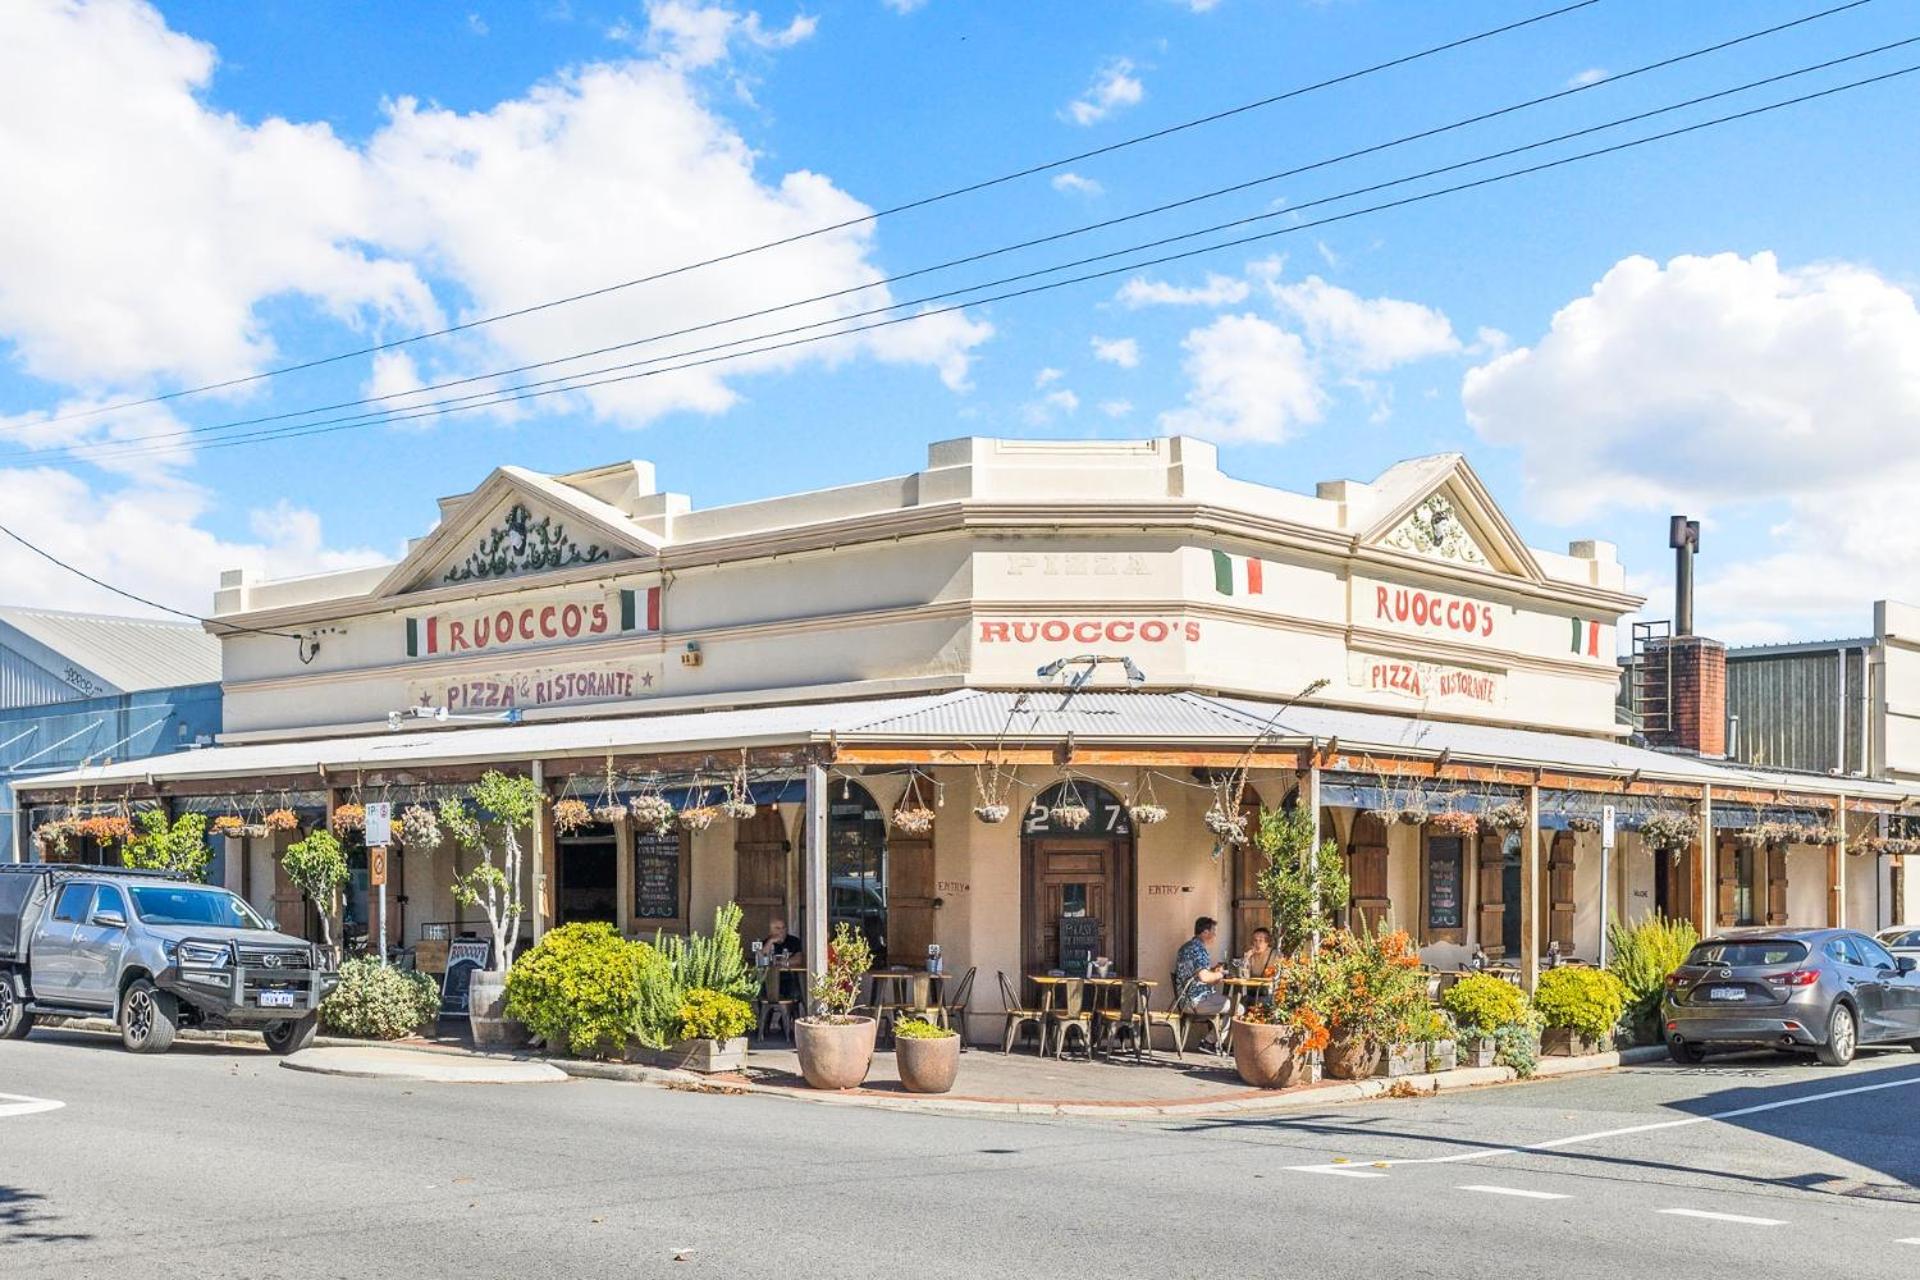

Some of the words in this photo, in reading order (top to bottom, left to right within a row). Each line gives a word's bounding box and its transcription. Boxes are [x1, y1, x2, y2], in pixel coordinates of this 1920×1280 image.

[1007, 554, 1152, 576] PIZZA
[1376, 586, 1494, 637] RUOCCO'S
[450, 603, 608, 651] RUOCCO'S
[979, 620, 1201, 643] RUOCCO'S
[447, 682, 515, 710] PIZZA
[536, 672, 634, 704] RISTORANTE
[1371, 664, 1421, 697] PIZZA
[1440, 671, 1495, 704] RISTORANTE
[937, 880, 965, 893] ENTRY
[1148, 884, 1182, 895] ENTRY
